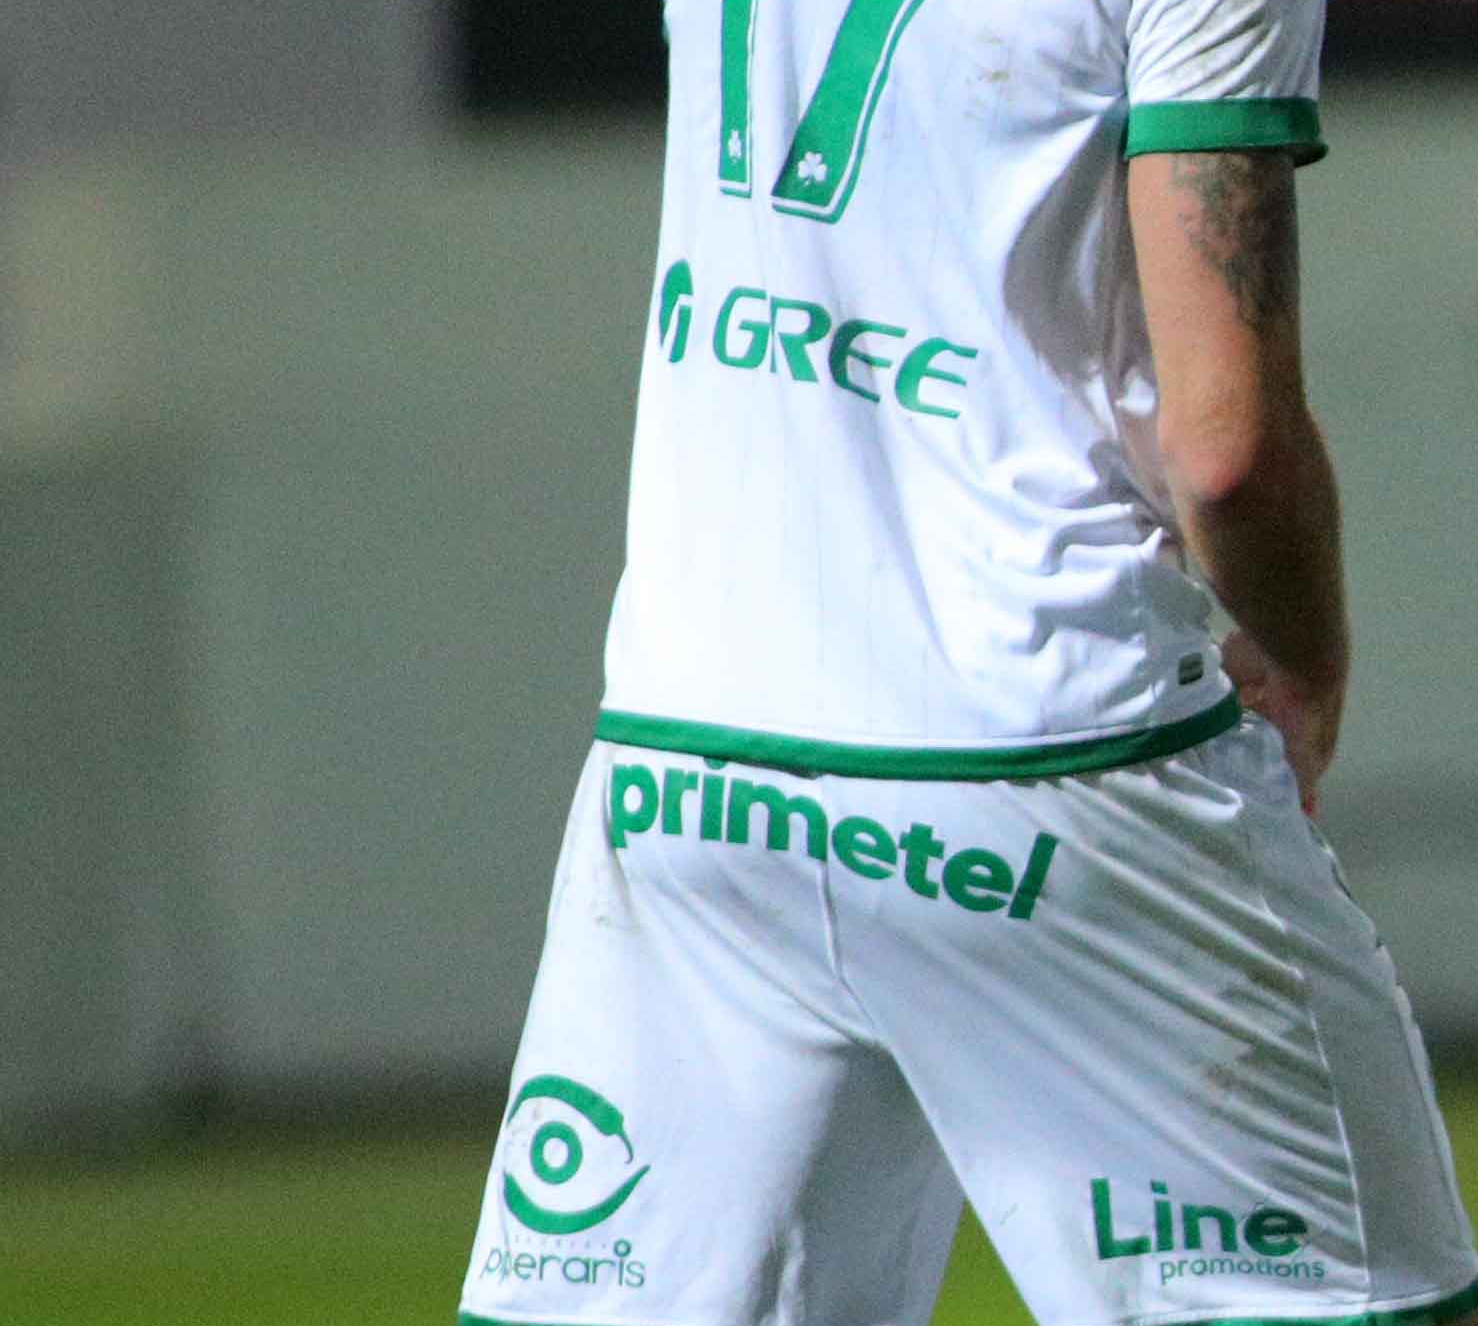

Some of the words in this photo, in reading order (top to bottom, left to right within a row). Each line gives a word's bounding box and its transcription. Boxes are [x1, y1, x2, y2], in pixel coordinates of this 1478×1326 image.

[714, 287, 978, 419] GREE
[609, 758, 1057, 921] primetel
[1091, 1177, 1308, 1260] Line
[1160, 1255, 1325, 1286] promotions
